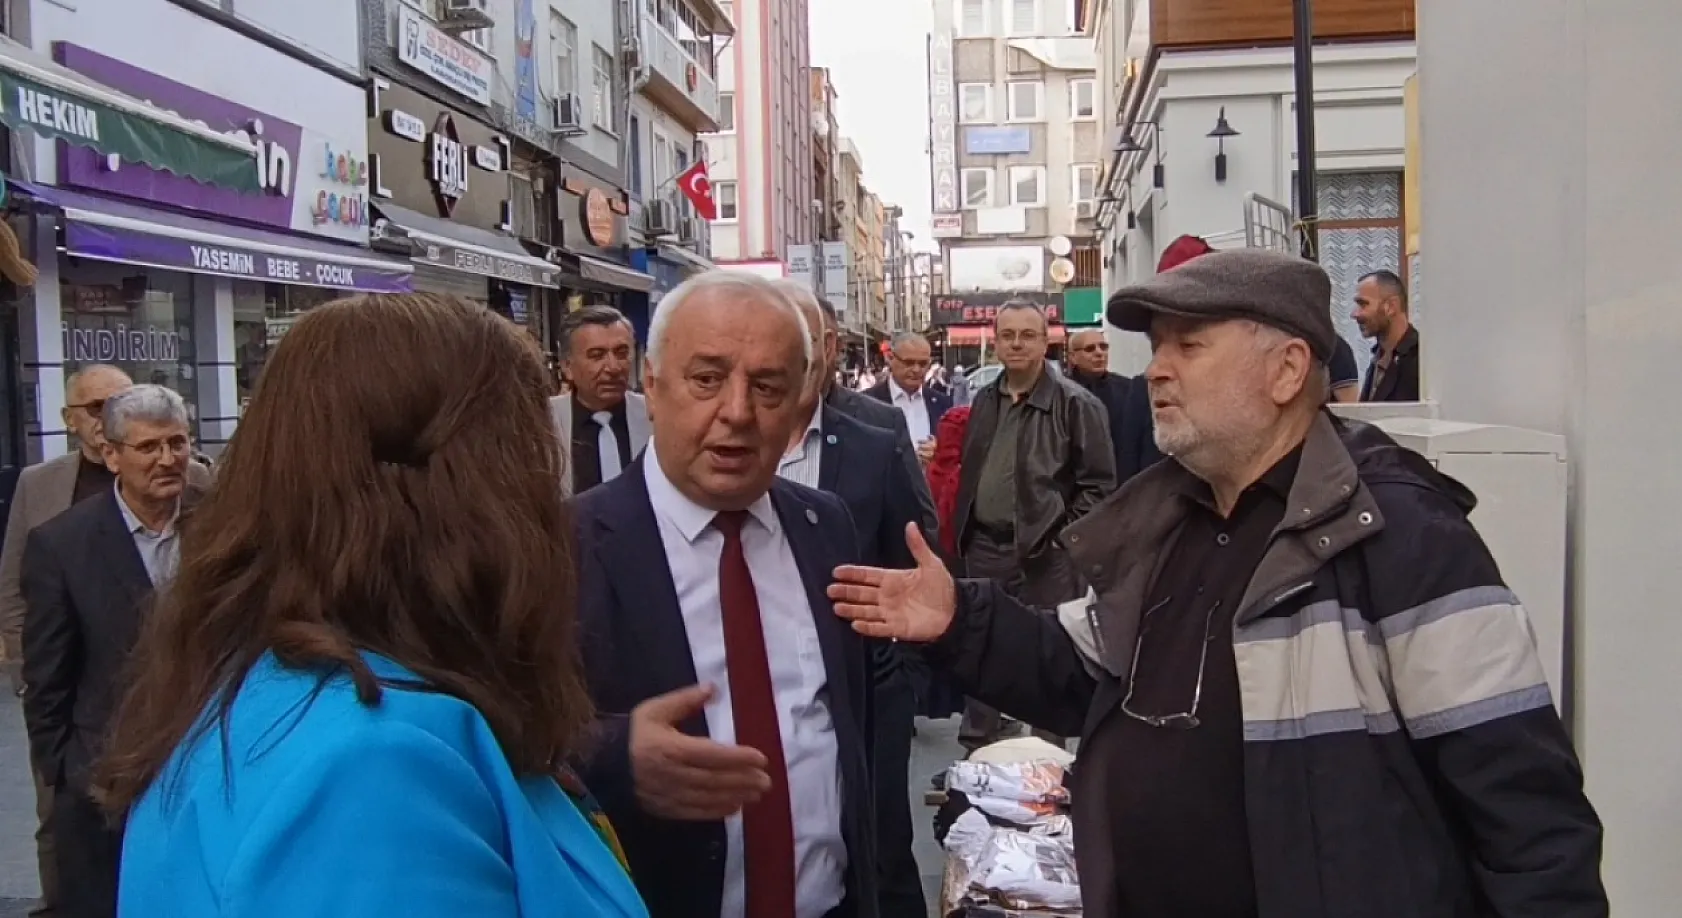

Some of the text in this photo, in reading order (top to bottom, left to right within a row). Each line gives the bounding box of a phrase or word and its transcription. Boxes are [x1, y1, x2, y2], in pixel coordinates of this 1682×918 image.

[934, 34, 952, 209] ALBAYRAK
[190, 246, 254, 274] YASEMİN
[267, 258, 300, 280] BEBE
[316, 264, 354, 286] ÇOCUK
